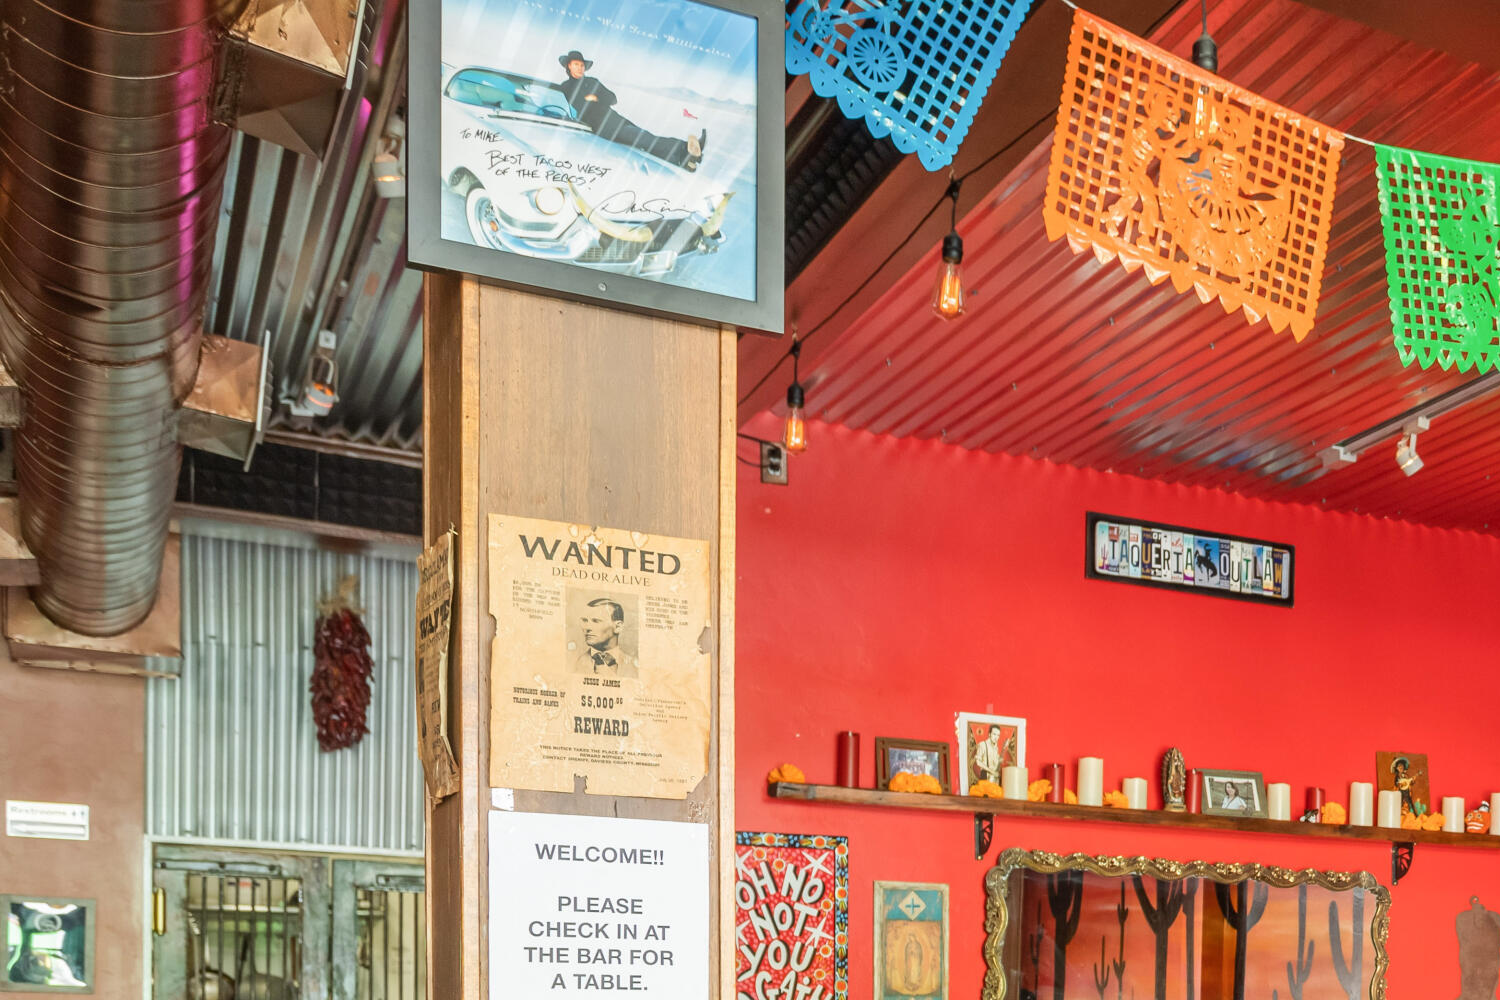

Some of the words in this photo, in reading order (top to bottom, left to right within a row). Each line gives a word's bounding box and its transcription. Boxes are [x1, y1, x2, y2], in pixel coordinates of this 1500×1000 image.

[474, 130, 504, 143] MIKE
[485, 150, 525, 171] BEST
[533, 154, 572, 170] TACOS
[577, 162, 615, 178] WEST
[495, 166, 510, 177] OF
[515, 168, 540, 179] THE
[518, 534, 681, 576] WANTED
[1109, 540, 1193, 575] TAQUERIA
[1220, 552, 1283, 583] OUTLAW
[552, 566, 588, 580] DEAD
[590, 570, 611, 584] OR
[611, 571, 651, 587] ALIVE
[574, 716, 629, 737] REWARD
[535, 843, 665, 866] WELCOME!!
[736, 861, 779, 911] OH
[781, 863, 826, 905] NO
[557, 896, 644, 915] PLEASE
[528, 921, 609, 940] CHECK
[617, 923, 638, 940] IN
[645, 924, 671, 941] AT
[748, 902, 822, 942] NOT
[524, 946, 569, 964] THE
[577, 948, 622, 966] BAR
[629, 950, 674, 967] FOR
[738, 939, 817, 982] YOU
[550, 973, 567, 990] A
[573, 974, 648, 991] TABLE.
